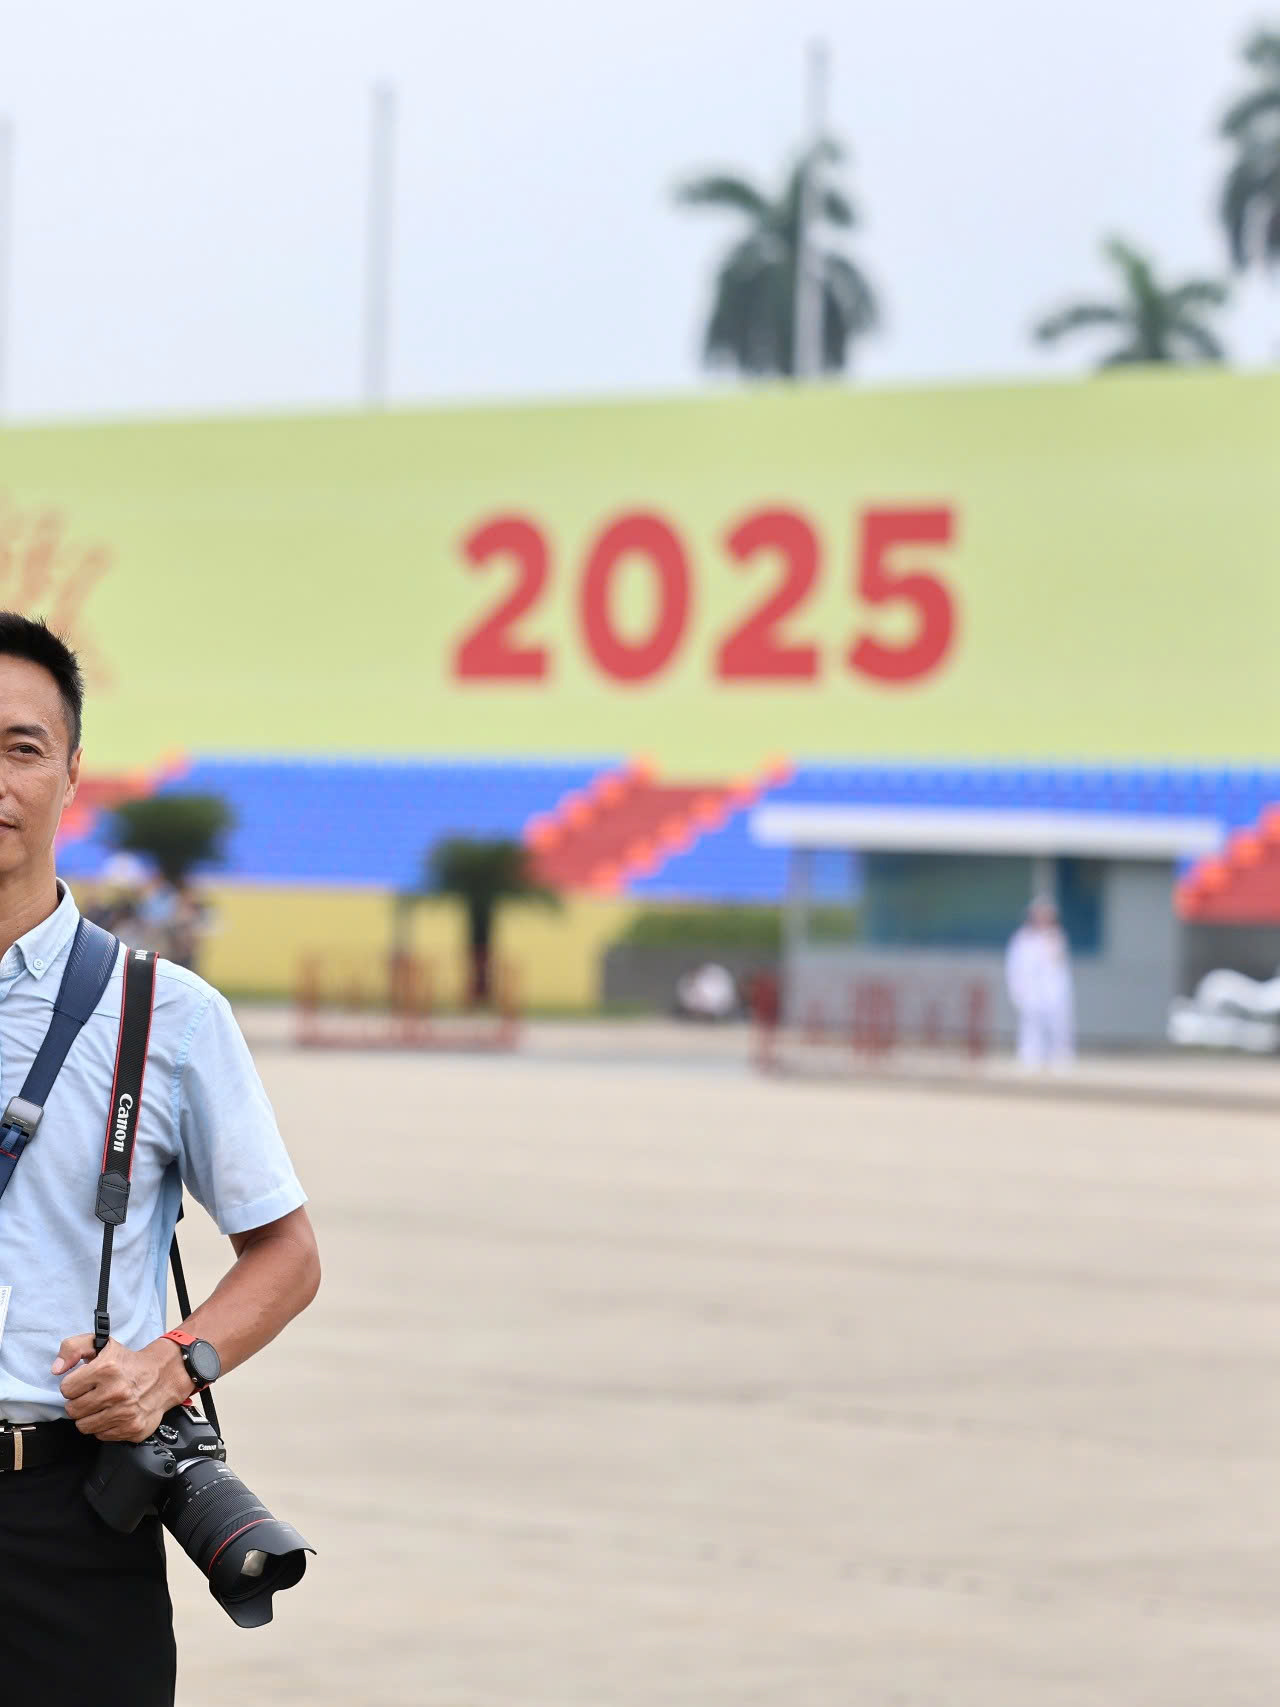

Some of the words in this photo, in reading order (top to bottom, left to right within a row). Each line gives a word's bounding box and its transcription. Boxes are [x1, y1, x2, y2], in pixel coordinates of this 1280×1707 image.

[451, 503, 959, 686] 2025
[113, 1093, 134, 1153] Canon
[198, 1443, 217, 1451] Canon
